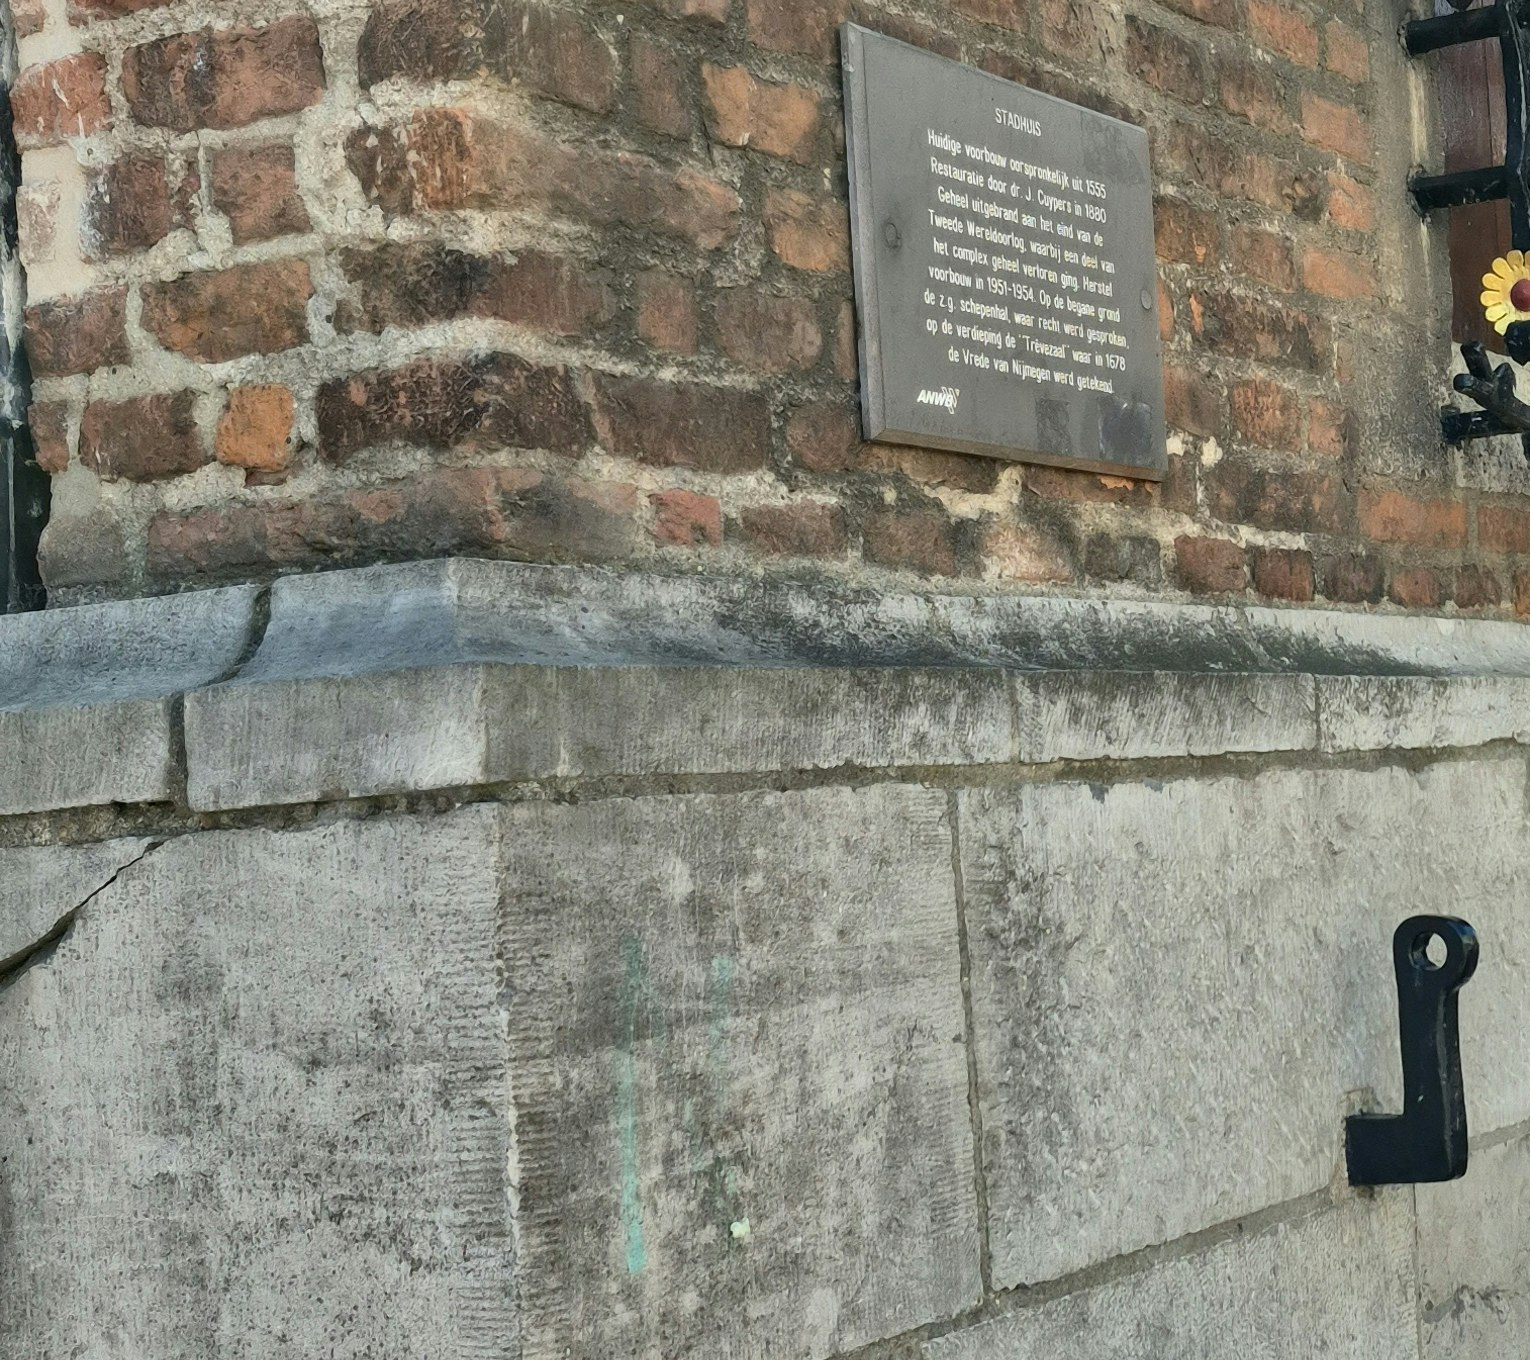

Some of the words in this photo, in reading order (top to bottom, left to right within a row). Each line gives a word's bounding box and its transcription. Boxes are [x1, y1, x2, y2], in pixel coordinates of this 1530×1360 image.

[995, 107, 1041, 136] STADHUIS
[927, 128, 961, 156] Huidige
[965, 145, 1007, 168] voorbouw
[1010, 158, 1069, 190] oorspronkelijk
[1072, 176, 1083, 192] uit
[1086, 179, 1106, 199] 1555
[931, 156, 984, 187] Restauratie
[988, 175, 1007, 194] door
[1011, 181, 1023, 198] dr.
[1026, 186, 1034, 201] J.
[1038, 189, 1071, 213] Cuypers
[1074, 200, 1081, 216] in
[1085, 203, 1106, 223] 1880
[928, 209, 963, 233] Tweede
[1030, 240, 1060, 263] waarbij
[1064, 250, 1078, 264] een
[1082, 253, 1098, 269] deel
[1101, 260, 1115, 274] van
[938, 186, 968, 209] Geheel
[972, 197, 1018, 223] uitgebrand
[1022, 213, 1036, 228] aan
[1040, 215, 1054, 233] het
[1057, 222, 1073, 239] eind
[1077, 229, 1090, 243] van
[1094, 231, 1103, 247] de
[929, 266, 971, 287] voorbouw
[976, 273, 983, 290] in
[987, 277, 1036, 302] 1951-1954.
[1040, 290, 1051, 309] Op
[1054, 294, 1064, 309] de
[1067, 296, 1095, 317] begane
[1098, 307, 1120, 323] grond
[934, 237, 949, 256] het
[953, 245, 988, 266] complex
[992, 254, 1019, 273] geheel
[1023, 263, 1057, 283] verloren
[1083, 276, 1112, 297] Herstel
[924, 288, 935, 305] de
[940, 294, 957, 313] z.g.
[1014, 312, 1034, 327] waar
[1039, 317, 1061, 333] recht
[1064, 323, 1083, 338] werd
[927, 319, 937, 335] op
[942, 318, 953, 334] de
[957, 325, 1001, 349] verdieping
[1005, 332, 1016, 348] de
[1072, 350, 1091, 364] waar
[1095, 351, 1103, 366] in
[1106, 354, 1126, 372] 1678
[949, 346, 959, 362] de
[963, 348, 990, 369] Vrede
[994, 359, 1009, 373] van
[1012, 359, 1051, 384] Nijmegen
[1054, 371, 1074, 386] werd
[917, 389, 953, 407] ANWB
